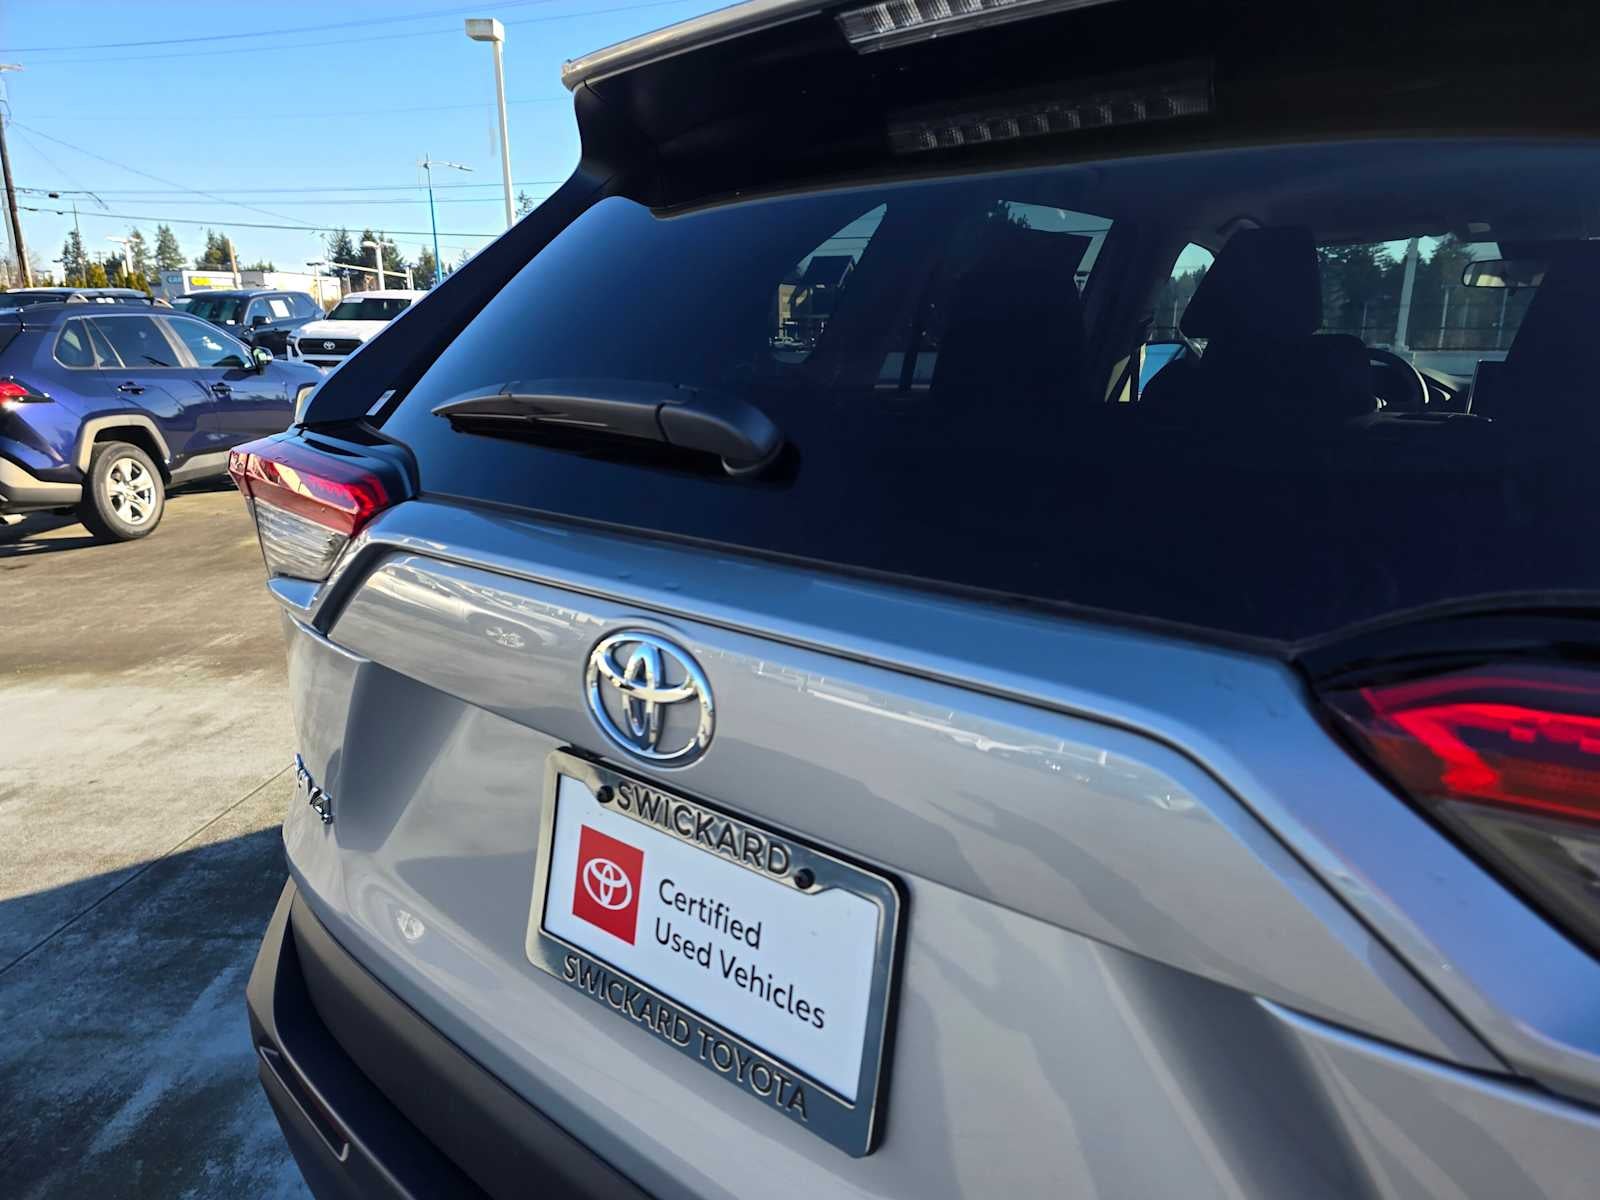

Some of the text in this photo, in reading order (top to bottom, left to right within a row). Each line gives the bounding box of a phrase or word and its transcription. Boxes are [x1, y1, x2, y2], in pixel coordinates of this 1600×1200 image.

[616, 781, 790, 878] SWICKARD
[658, 878, 762, 950] Certified
[655, 917, 825, 1029] Used Vehicles
[563, 955, 808, 1121] SWICKARD TOYOTA
